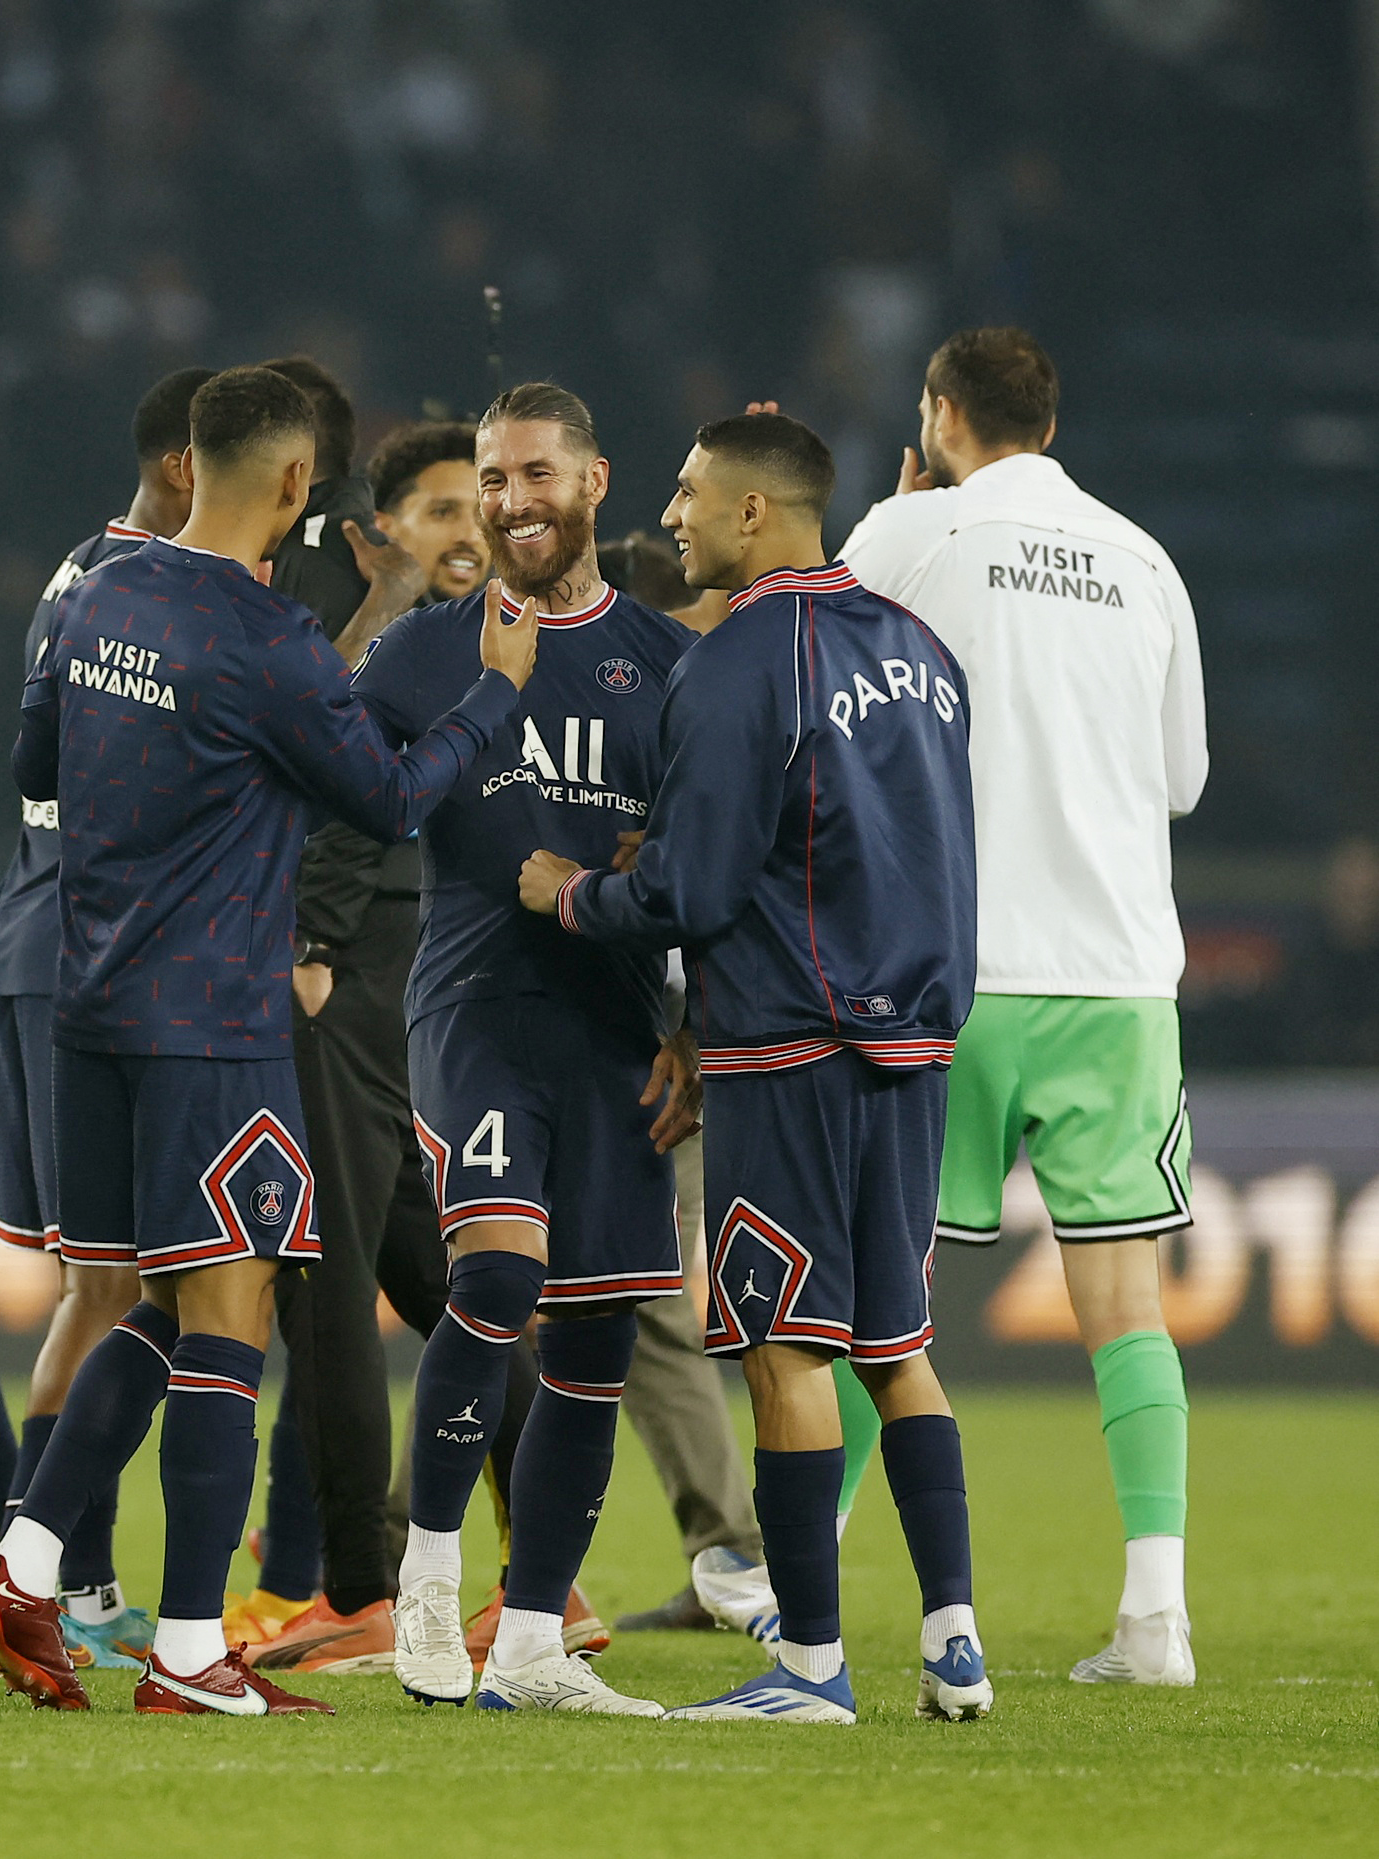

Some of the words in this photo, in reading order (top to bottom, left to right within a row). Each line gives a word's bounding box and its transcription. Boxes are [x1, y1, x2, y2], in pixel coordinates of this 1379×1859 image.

[1018, 540, 1095, 575] VISIT
[988, 564, 1125, 609] RWANDA
[97, 636, 161, 677] VISIT
[68, 657, 178, 712] RWANDA
[828, 658, 961, 742] PARIS
[480, 767, 539, 799] ACCOR
[567, 787, 649, 818] LIMITLESS
[462, 1109, 512, 1178] 4
[257, 1183, 284, 1195] PARIS
[435, 1427, 486, 1444] PARIS
